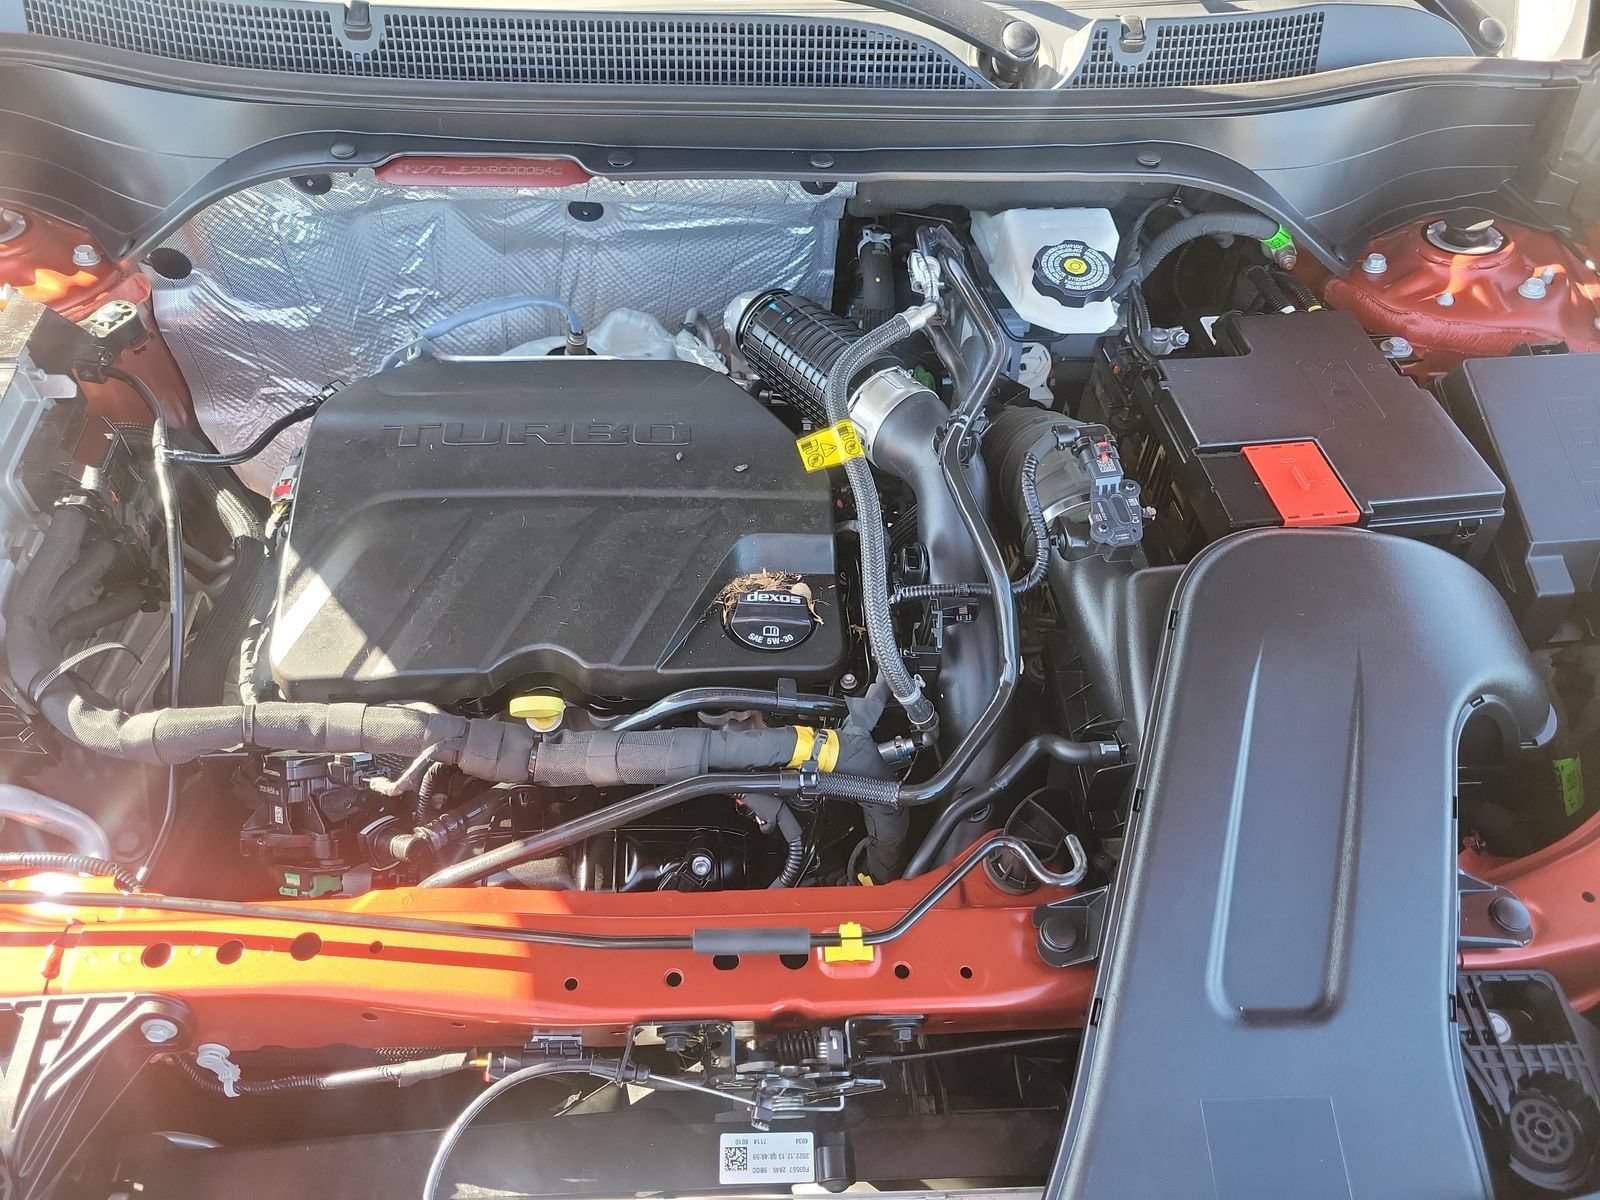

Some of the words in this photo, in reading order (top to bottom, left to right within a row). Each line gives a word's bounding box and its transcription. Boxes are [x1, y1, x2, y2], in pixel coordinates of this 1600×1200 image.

[381, 422, 692, 447] TURBO
[746, 591, 802, 604] dexos
[748, 632, 764, 644] SAE
[766, 633, 794, 645] 5W-30
